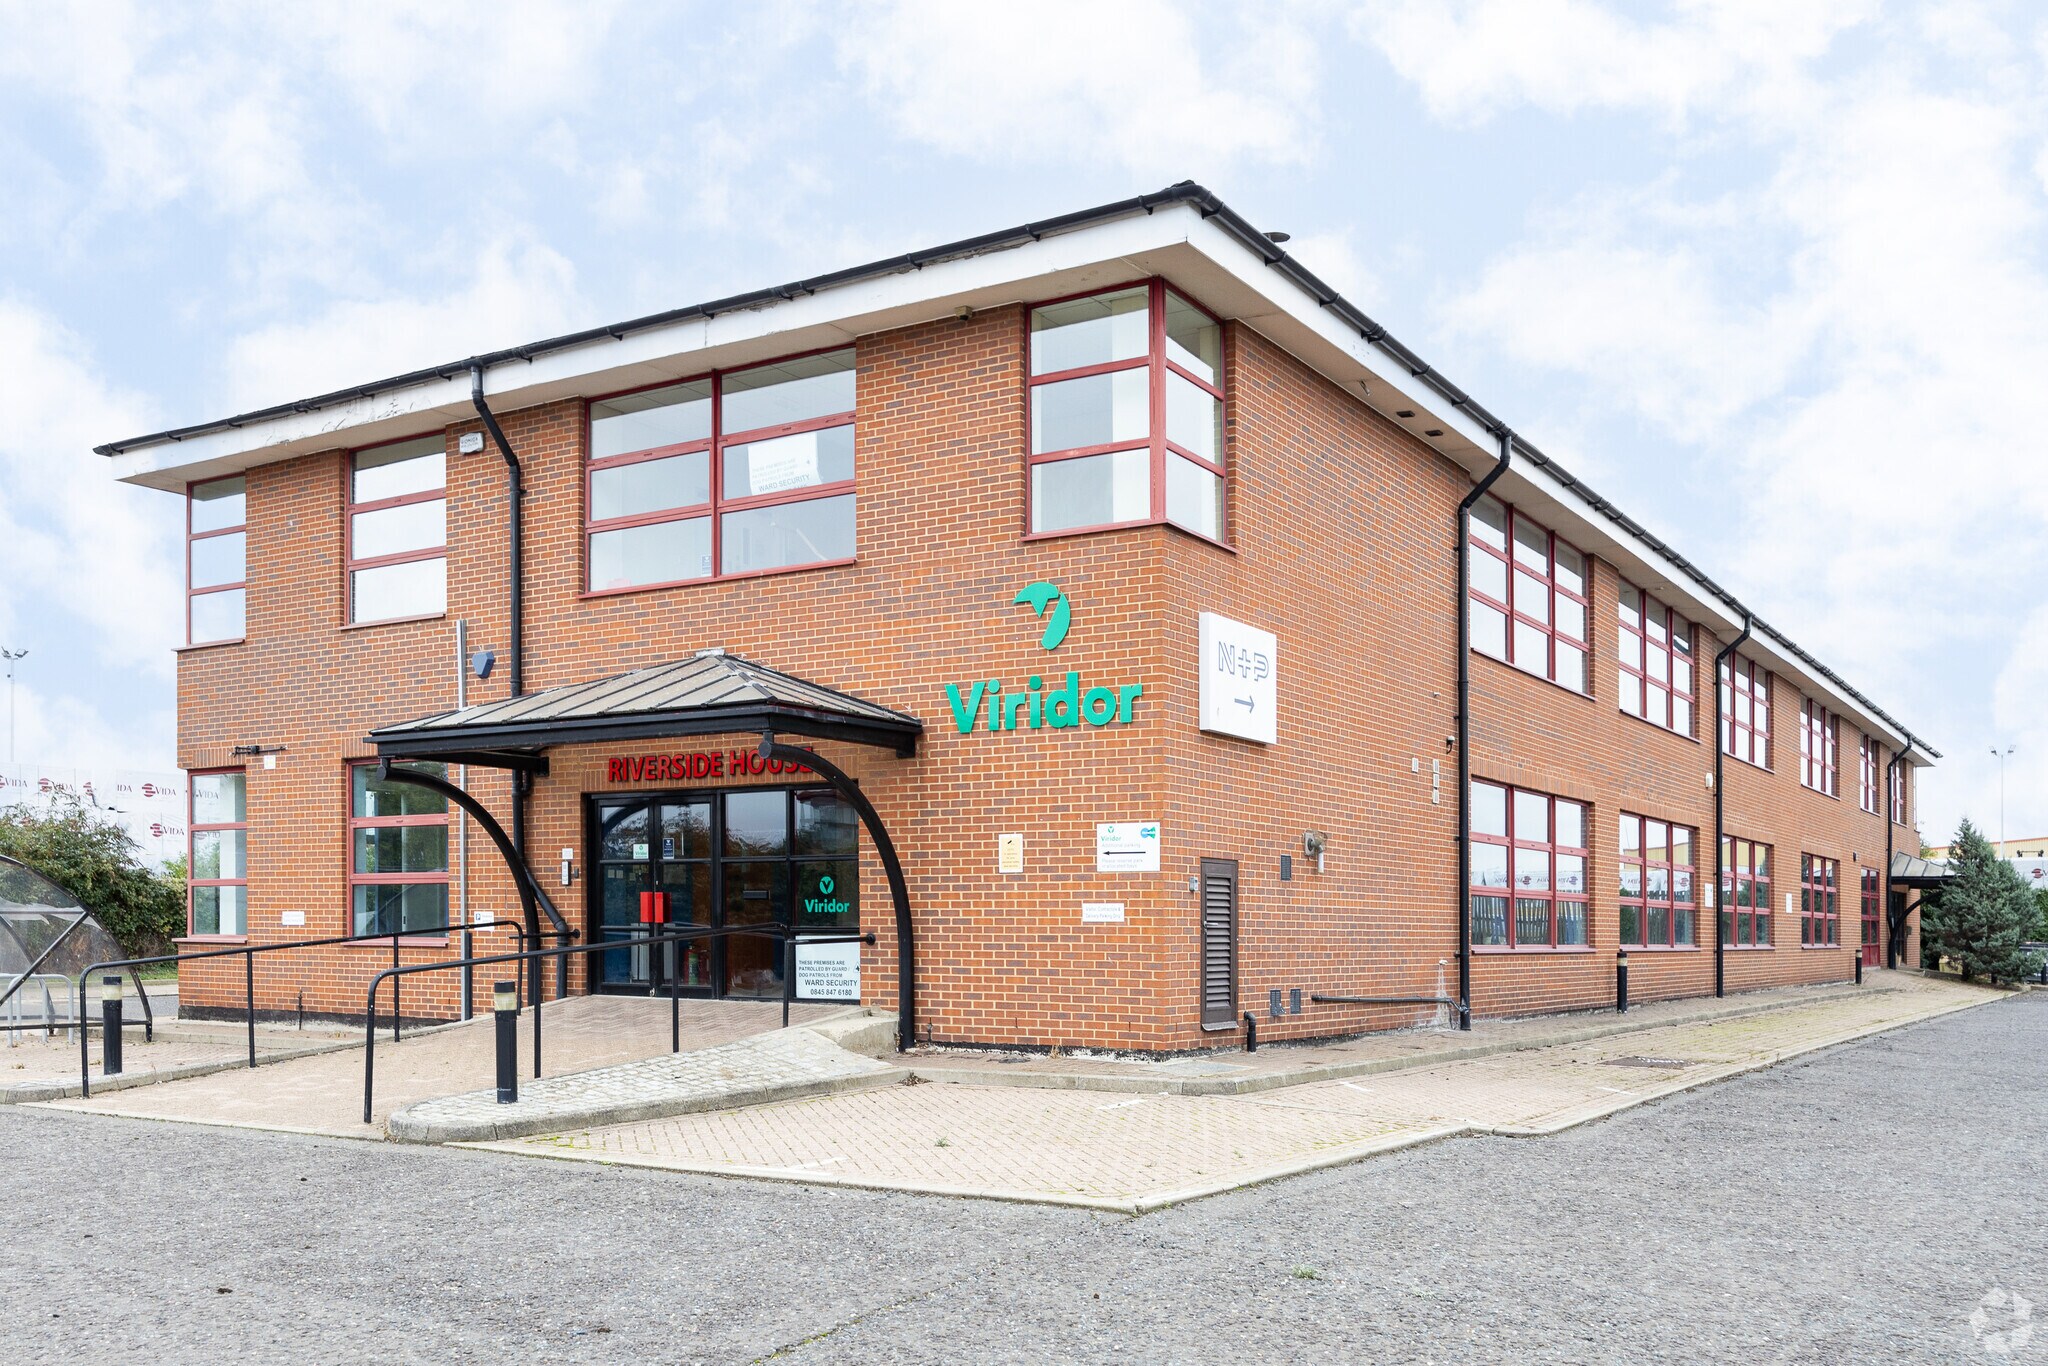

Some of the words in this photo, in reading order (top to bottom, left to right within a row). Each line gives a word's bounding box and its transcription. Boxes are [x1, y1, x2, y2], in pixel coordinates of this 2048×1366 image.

[758, 482, 778, 492] WARD
[778, 474, 810, 487] SECURITY
[944, 672, 1143, 734] Viridor
[608, 752, 724, 781] RIVERSIDE
[4, 778, 28, 787] VIDA
[117, 784, 132, 792] IDA
[155, 786, 176, 796] VIDA
[163, 826, 184, 835] VIDA
[804, 898, 850, 912] Viridor
